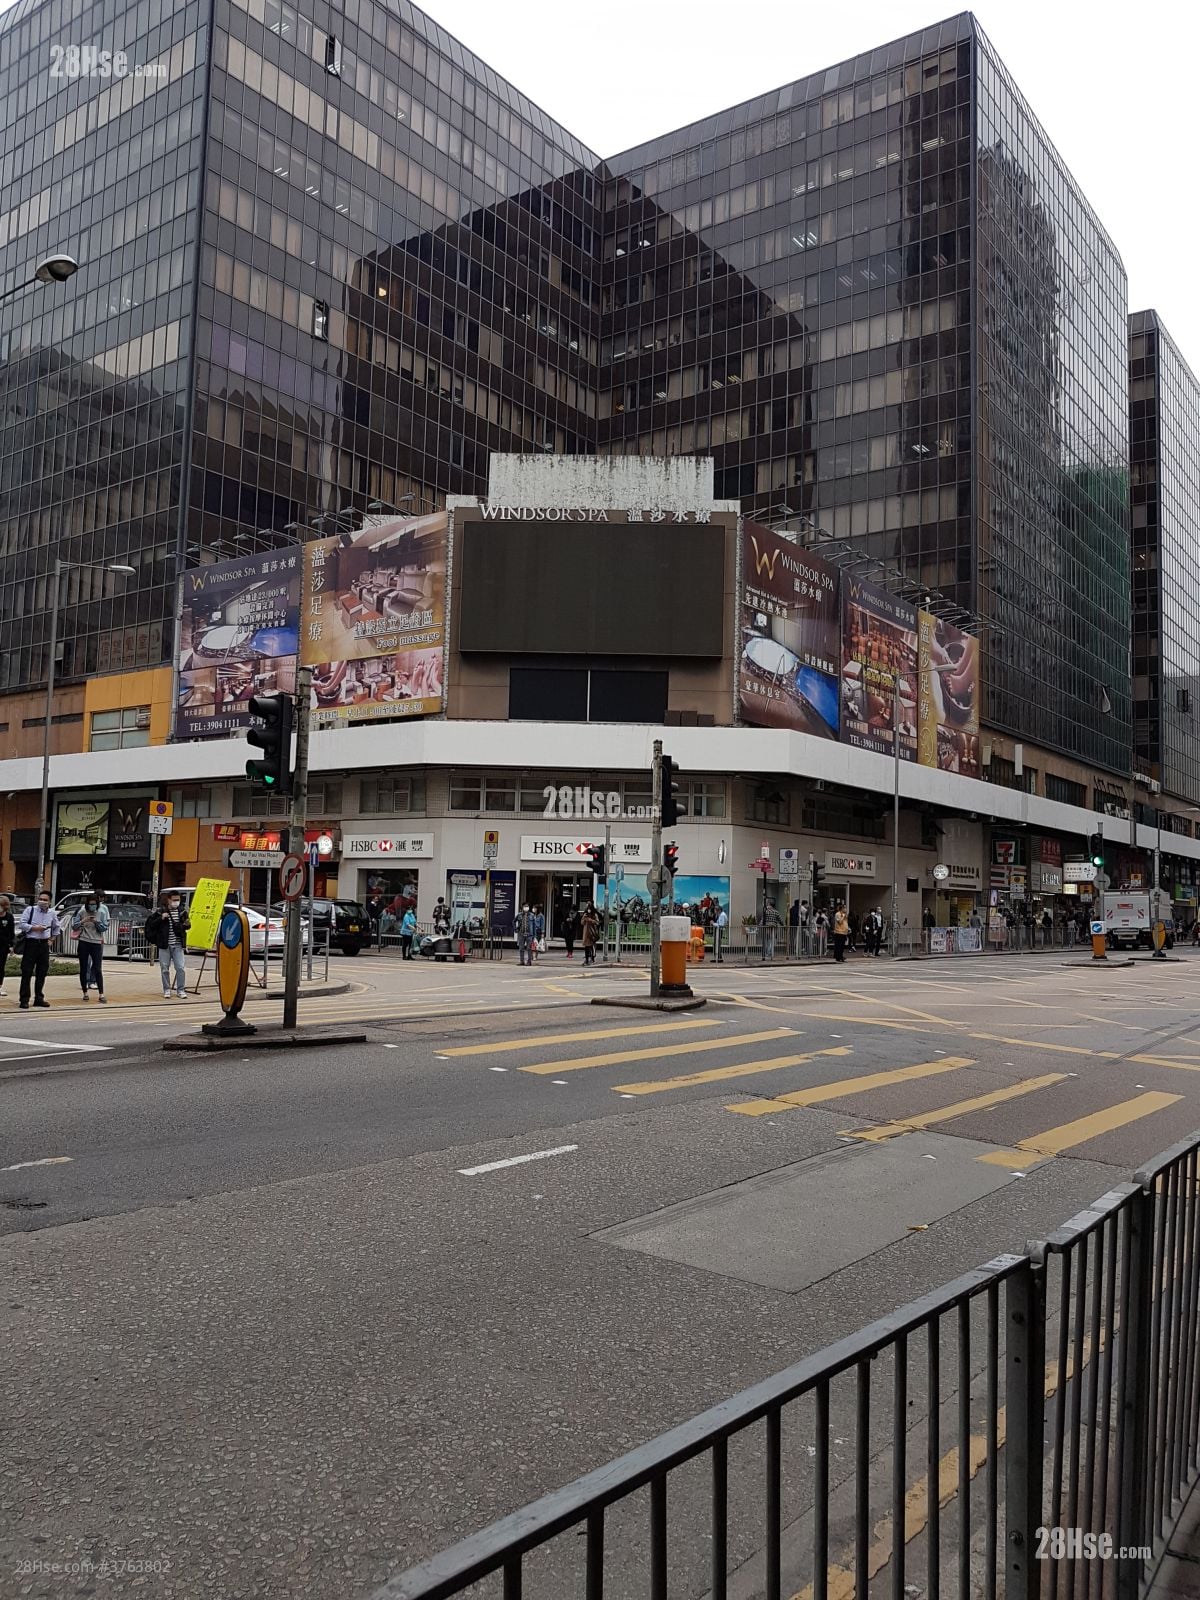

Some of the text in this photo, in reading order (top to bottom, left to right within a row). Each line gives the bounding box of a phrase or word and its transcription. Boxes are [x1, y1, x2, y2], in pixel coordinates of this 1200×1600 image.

[479, 503, 610, 522] WINDSOR SPA
[209, 567, 256, 584] WINDSOR SPA
[781, 552, 835, 591] WINDSOR SPA
[377, 631, 440, 649] Foot massage
[351, 840, 377, 852] HSBC
[533, 842, 574, 855] HSBC
[831, 857, 848, 870] HSBC
